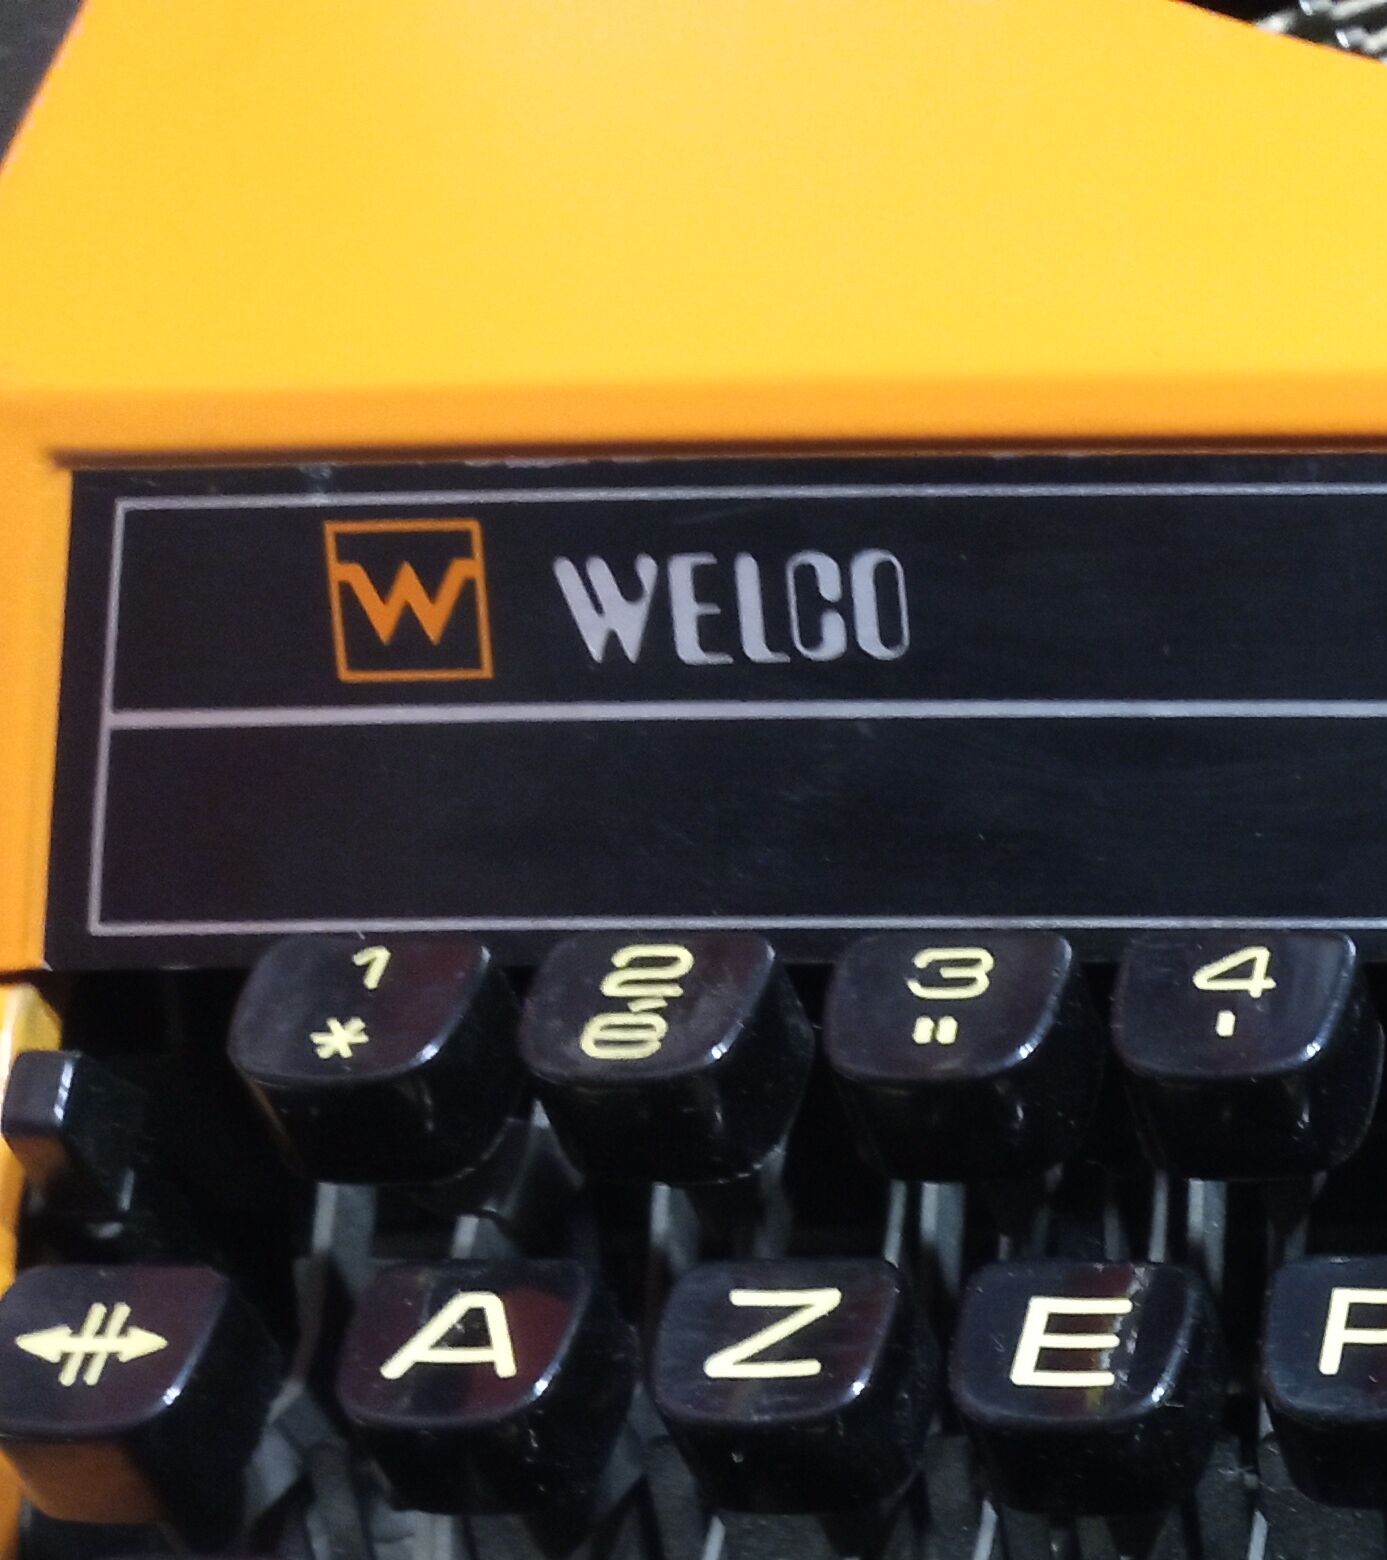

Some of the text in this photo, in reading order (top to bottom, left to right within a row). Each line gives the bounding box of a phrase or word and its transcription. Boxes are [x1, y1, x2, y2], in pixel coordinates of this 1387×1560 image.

[553, 549, 911, 665] WELCO
[353, 946, 391, 989] 1
[600, 944, 695, 998] 2
[907, 947, 994, 999] 3
[1192, 946, 1277, 998] 4
[380, 1291, 517, 1380] A
[703, 1287, 842, 1379] Z
[1009, 1296, 1133, 1387] E
